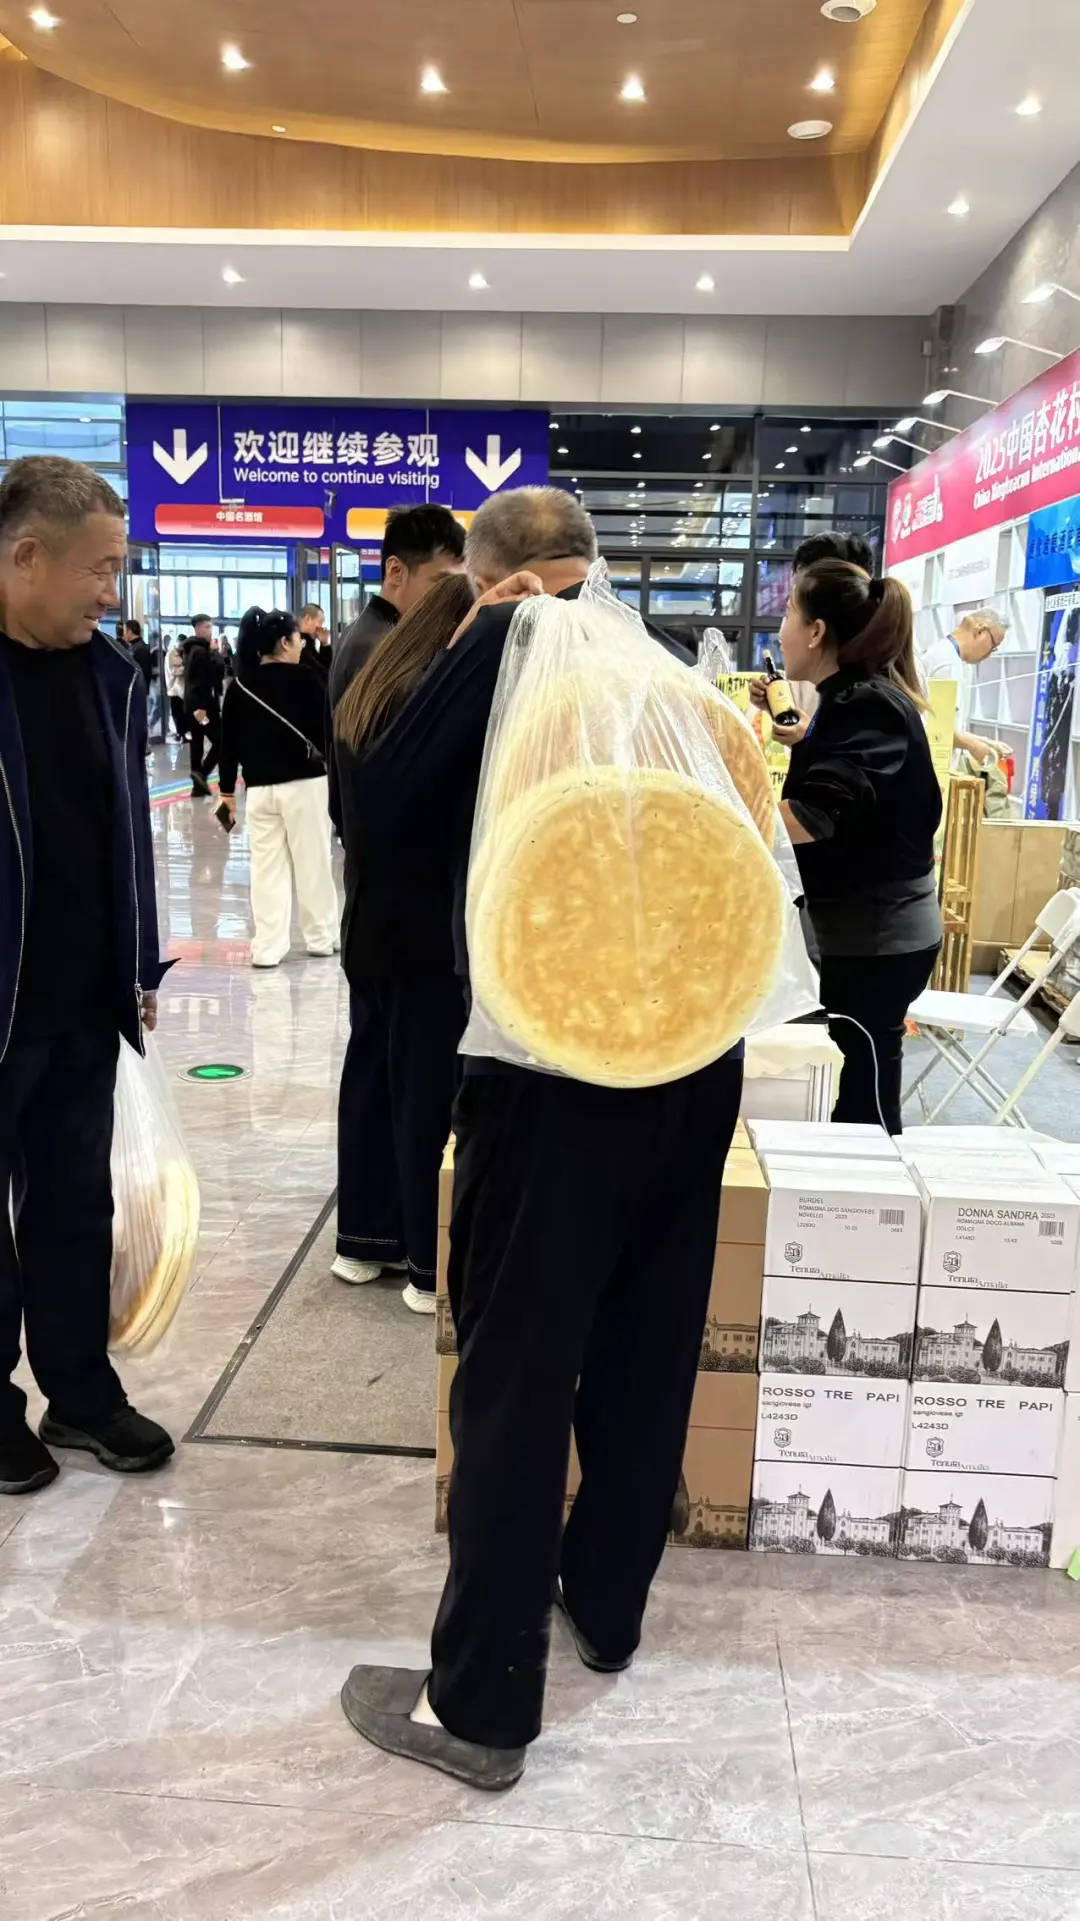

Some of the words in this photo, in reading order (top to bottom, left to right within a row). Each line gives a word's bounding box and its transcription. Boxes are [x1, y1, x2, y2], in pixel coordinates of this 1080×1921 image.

[233, 431, 439, 467] 欢迎继续参观
[233, 467, 299, 483] Welcome
[303, 469, 318, 483] to
[321, 471, 384, 484] continue
[388, 471, 440, 489] visiting
[216, 511, 263, 523] 中国名酒馆
[958, 1207, 994, 1219] DONNA
[997, 1210, 1039, 1221] SANDRA
[789, 1265, 820, 1274] Tenuta
[947, 1275, 978, 1284] Tenuta
[762, 1387, 815, 1398] ROSSO
[824, 1389, 853, 1400] TRE
[866, 1392, 900, 1403] PAPI
[761, 1400, 801, 1408] sangiovese
[802, 1401, 812, 1409] igt
[914, 1396, 967, 1407] ROSSO
[976, 1399, 1006, 1409] TRE
[1019, 1401, 1053, 1412] PAPI
[761, 1412, 798, 1421] L4243D
[912, 1422, 949, 1430] L4243D
[778, 1449, 808, 1458] Tenuta
[930, 1459, 960, 1467] Tenuta
